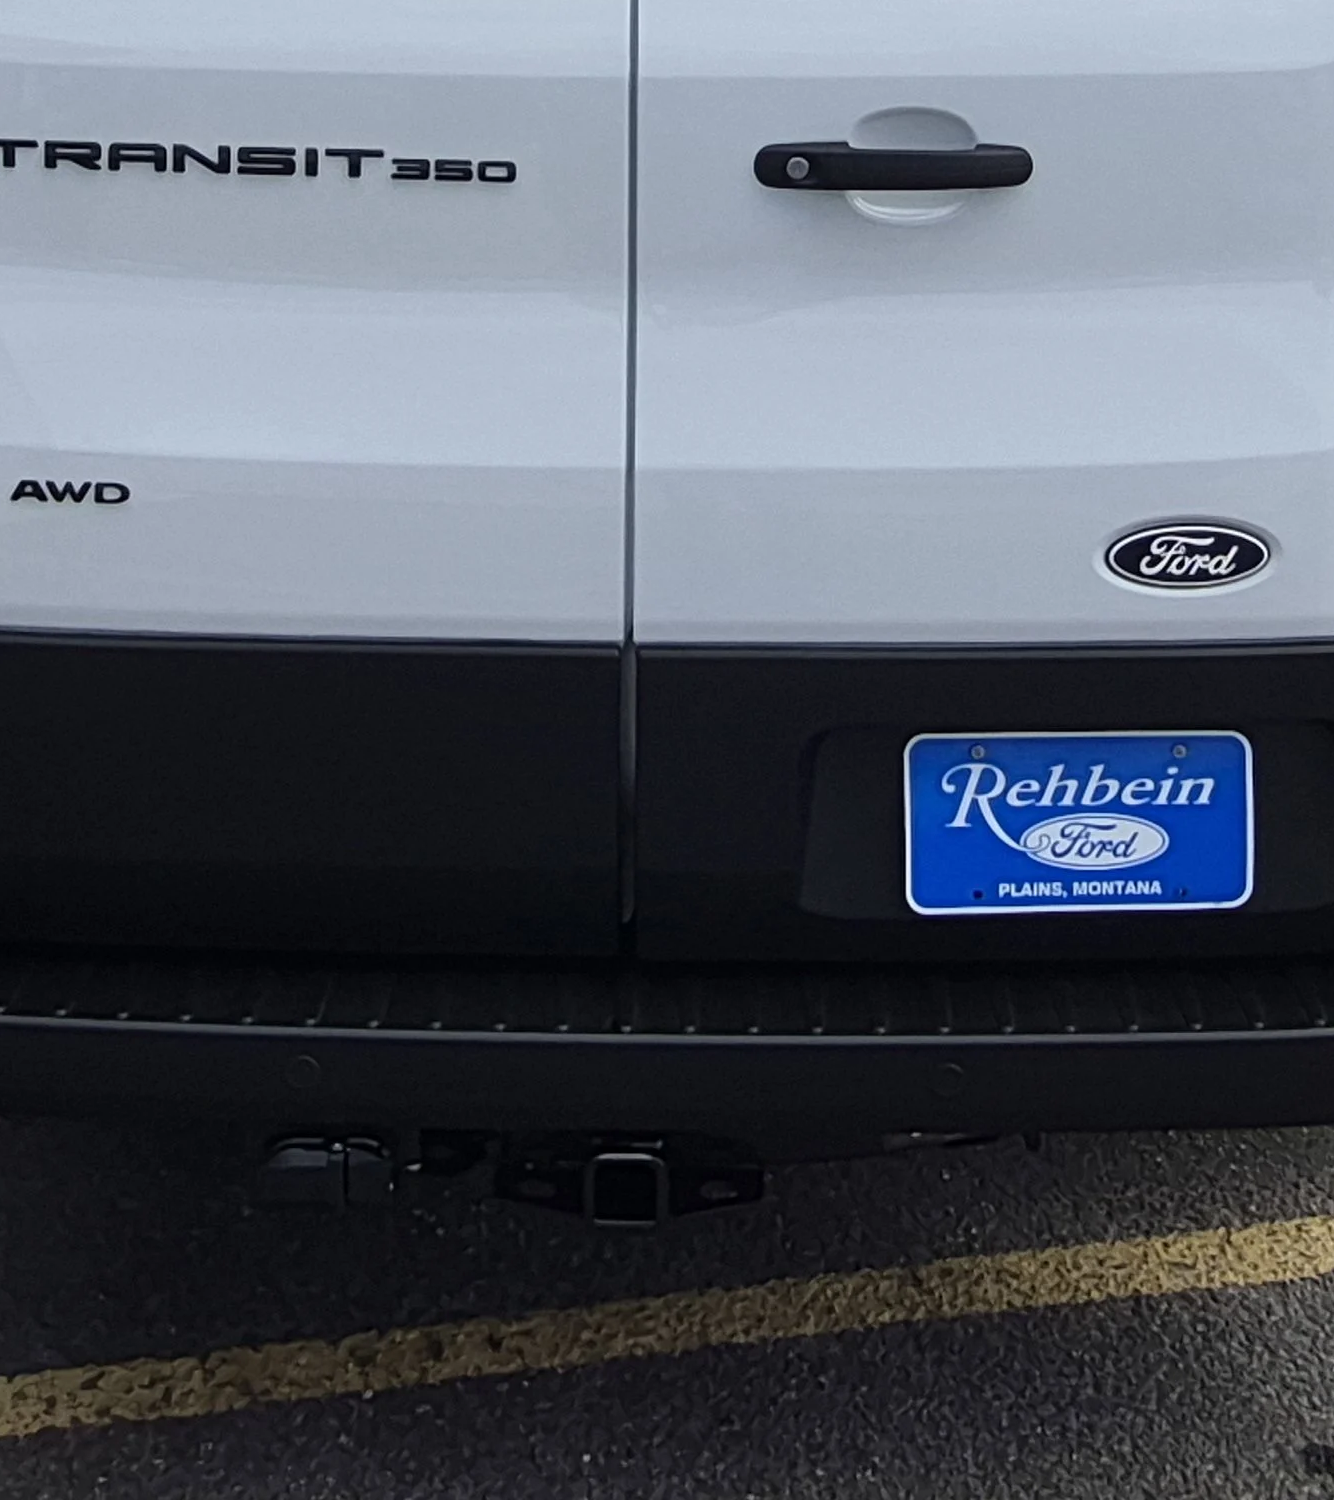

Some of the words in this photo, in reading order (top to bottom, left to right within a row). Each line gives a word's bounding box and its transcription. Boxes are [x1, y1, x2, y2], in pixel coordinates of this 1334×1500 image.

[391, 158, 517, 182] 350
[10, 480, 131, 505] AWD
[1139, 536, 1239, 576] Ford
[941, 763, 1215, 848] Rehbein
[1051, 823, 1138, 858] Ford
[998, 881, 1068, 898] PLAINS,
[1072, 880, 1163, 897] MONTANA
